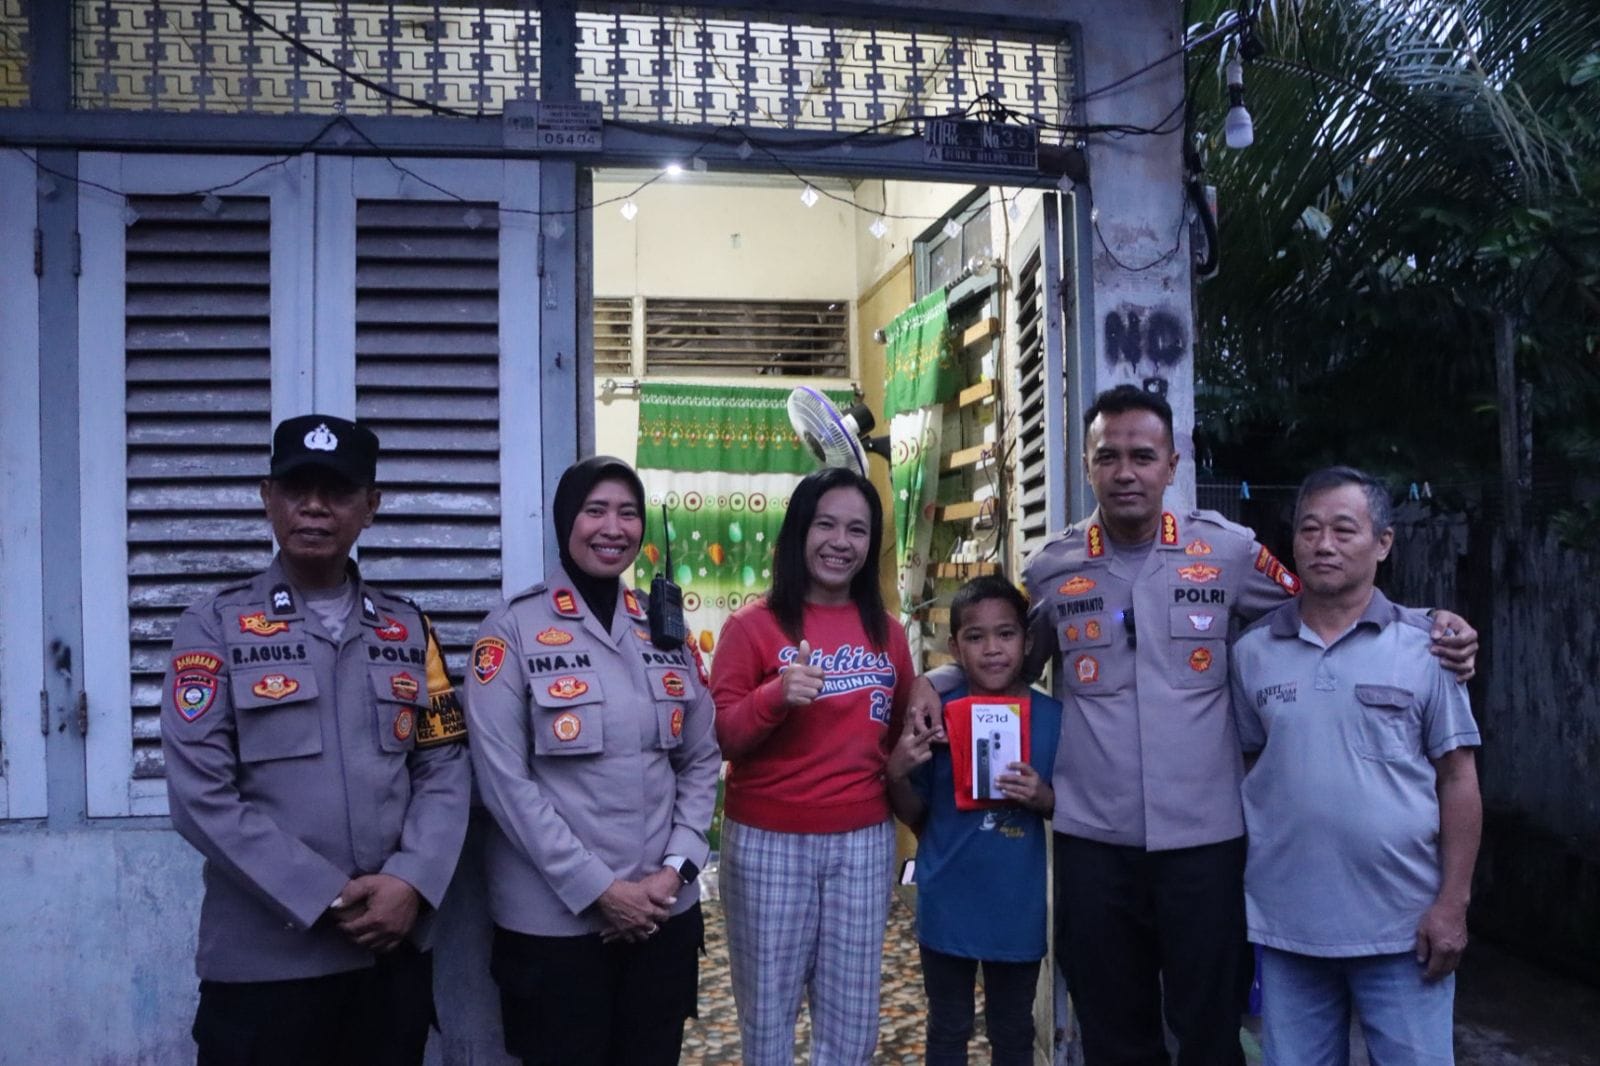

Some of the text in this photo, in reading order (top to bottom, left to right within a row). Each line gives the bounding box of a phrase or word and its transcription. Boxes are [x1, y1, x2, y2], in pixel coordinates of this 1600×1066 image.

[1174, 588, 1225, 604] POLRI
[232, 643, 306, 665] R.AGUS.S
[368, 645, 426, 665] POLRI
[528, 653, 592, 673] INA.N
[642, 652, 688, 667] POLRI
[821, 674, 882, 693] RIGINAL
[976, 713, 1009, 723] Y21d
